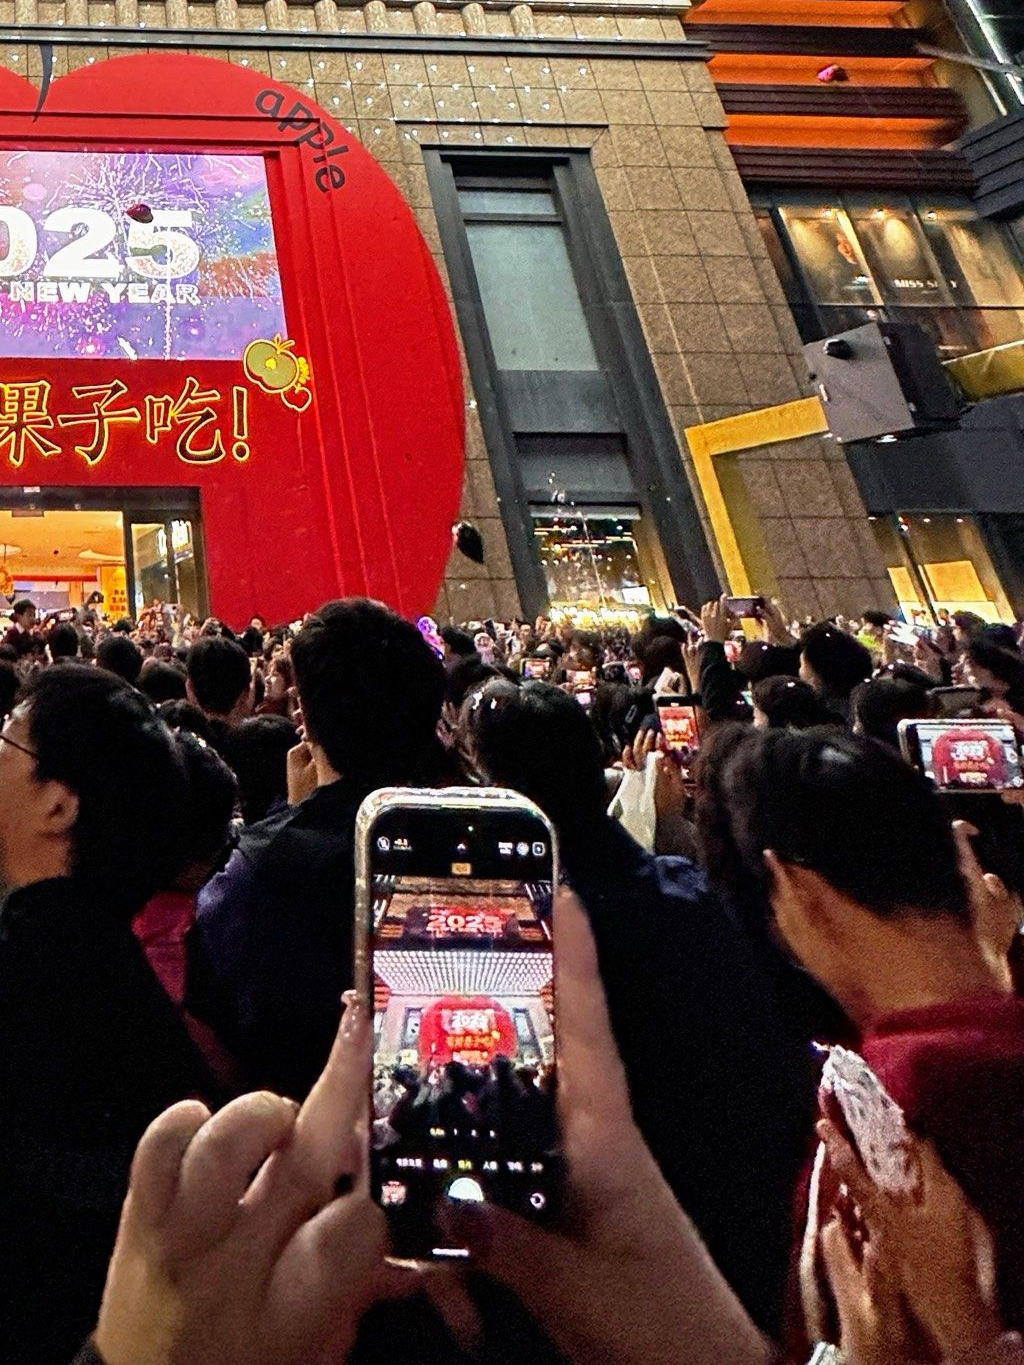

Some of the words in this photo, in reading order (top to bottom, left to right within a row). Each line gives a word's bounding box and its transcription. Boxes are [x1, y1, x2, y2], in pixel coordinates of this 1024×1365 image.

[255, 90, 349, 193] apple
[10, 281, 92, 303] NEW
[102, 283, 201, 305] YEAR
